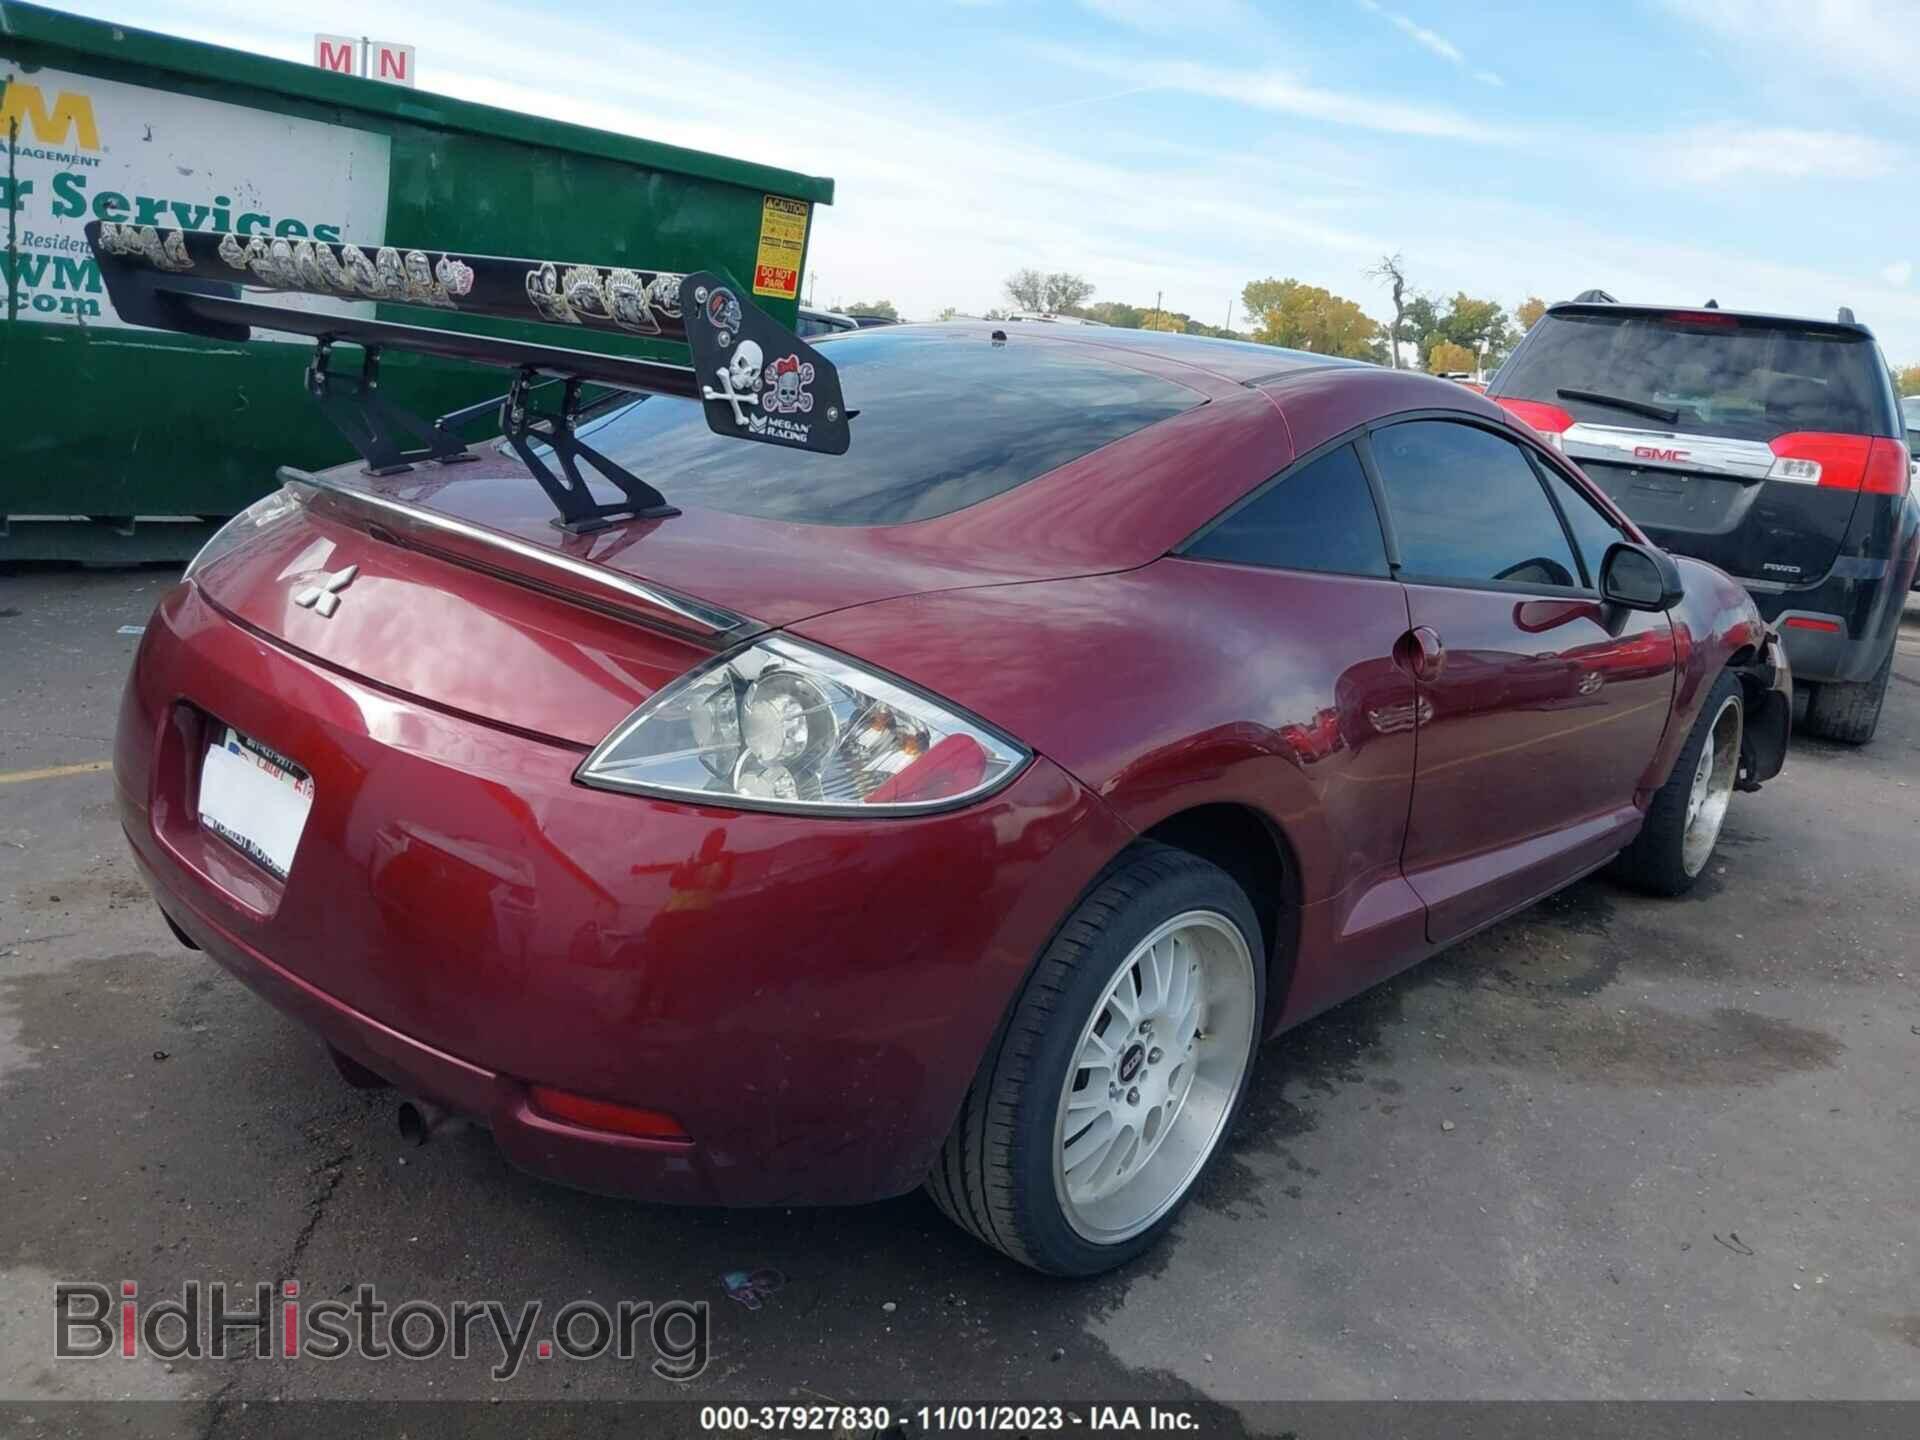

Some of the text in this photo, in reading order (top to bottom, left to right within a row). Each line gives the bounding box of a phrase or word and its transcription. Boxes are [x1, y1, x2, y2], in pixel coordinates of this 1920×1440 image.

[320, 42, 352, 74] M
[380, 48, 406, 79] N
[51, 172, 341, 242] Services
[760, 265, 792, 280] DO NOT
[763, 277, 785, 289] PARK
[769, 417, 809, 433] MEGAN
[767, 427, 808, 443] RACING
[1634, 446, 1691, 463] GMC
